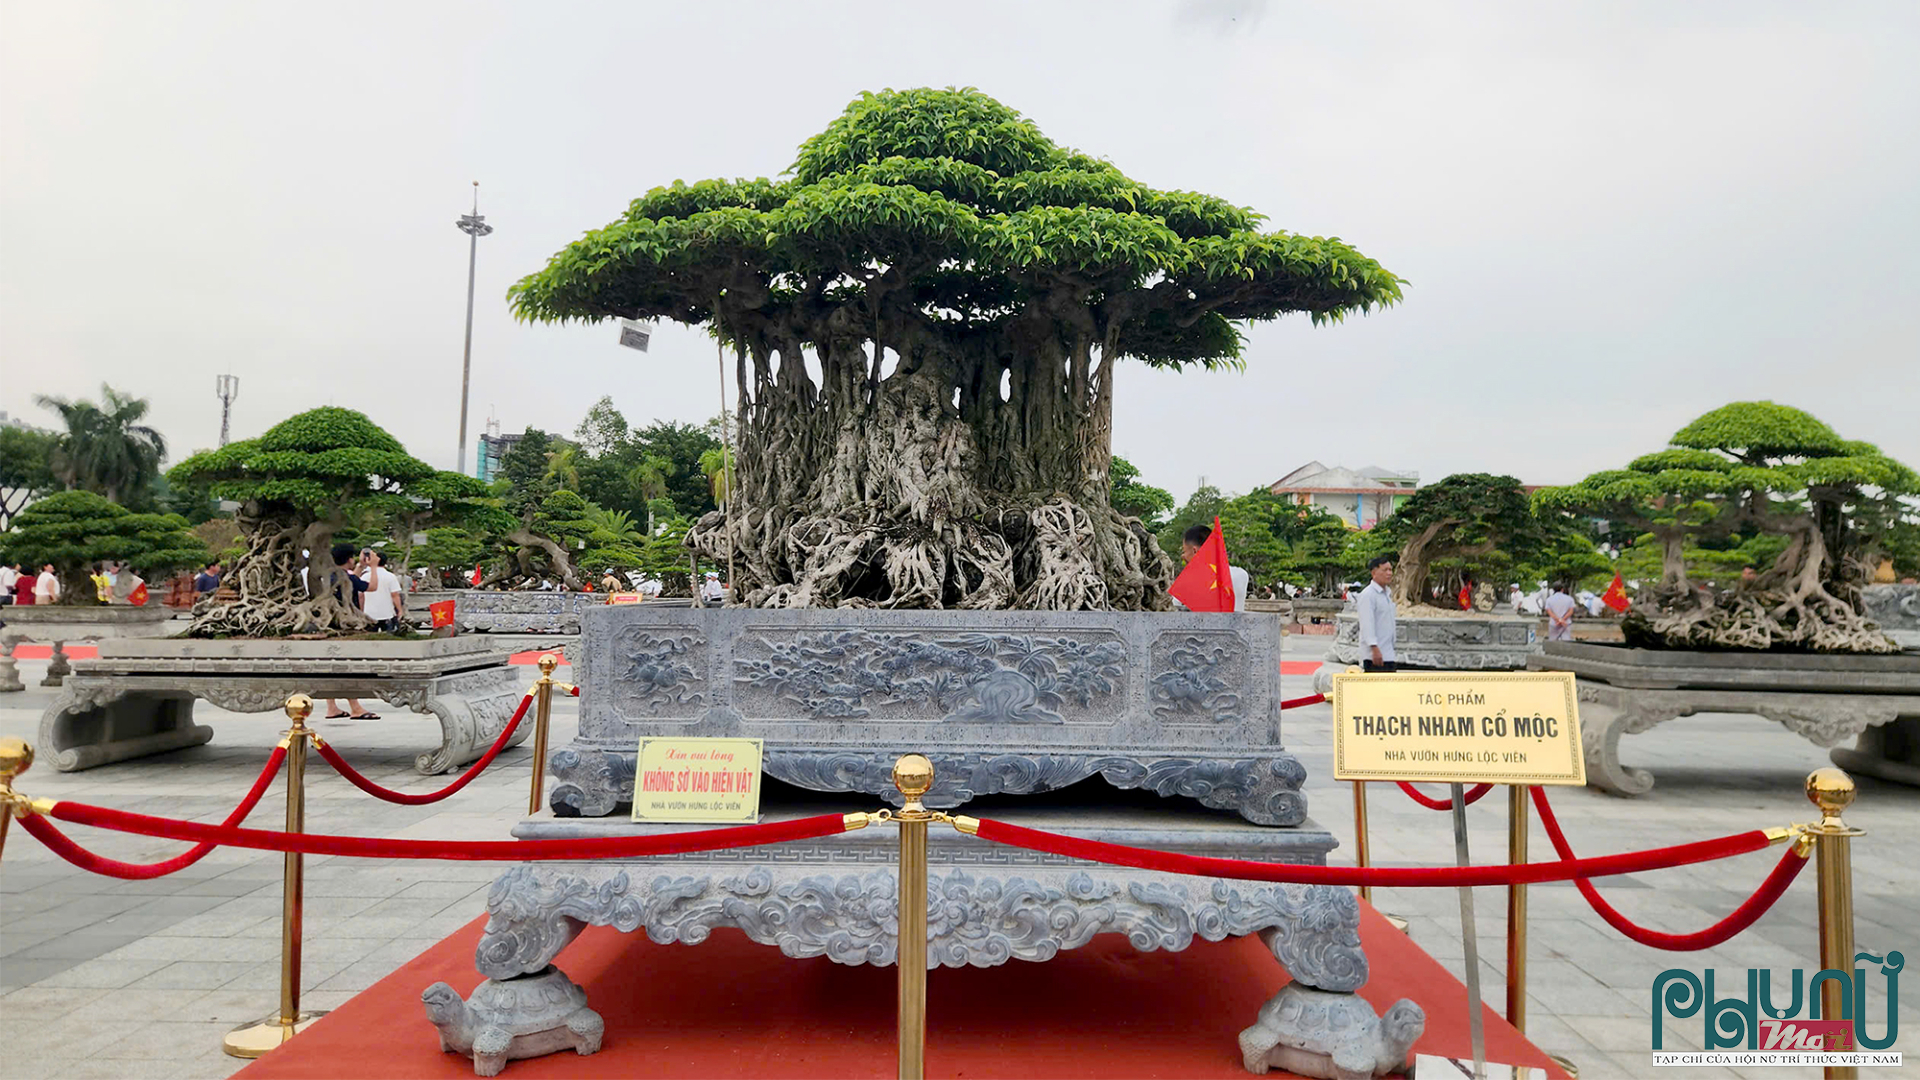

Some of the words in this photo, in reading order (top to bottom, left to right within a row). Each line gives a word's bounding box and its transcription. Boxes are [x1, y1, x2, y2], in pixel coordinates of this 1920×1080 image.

[1418, 691, 1442, 705] TÁC
[1448, 688, 1485, 705] PHẨM
[1353, 715, 1411, 740] THẠCH
[1419, 717, 1475, 737] NHAM
[1482, 708, 1507, 737] CỔ
[1514, 712, 1558, 743] MỘC
[666, 749, 687, 760] Xin
[690, 751, 707, 760] vui
[710, 749, 734, 762] lòng
[1385, 750, 1406, 761] NHÀ
[1411, 750, 1439, 761] VƯỜN
[1443, 751, 1473, 762] HƯNG
[1478, 750, 1498, 764] LỘC
[1503, 751, 1527, 763] VIÊN
[643, 766, 674, 792] KHÔNG
[676, 766, 690, 792] SỜ
[692, 767, 709, 793] VÀO
[711, 767, 733, 797] HIỆN
[736, 767, 752, 798] VẬT
[651, 801, 665, 810] NHÀ
[669, 801, 686, 810] VƯỜN
[689, 801, 708, 810] HƯNG
[710, 802, 723, 811] LỘC
[726, 802, 741, 810] VIÊN
